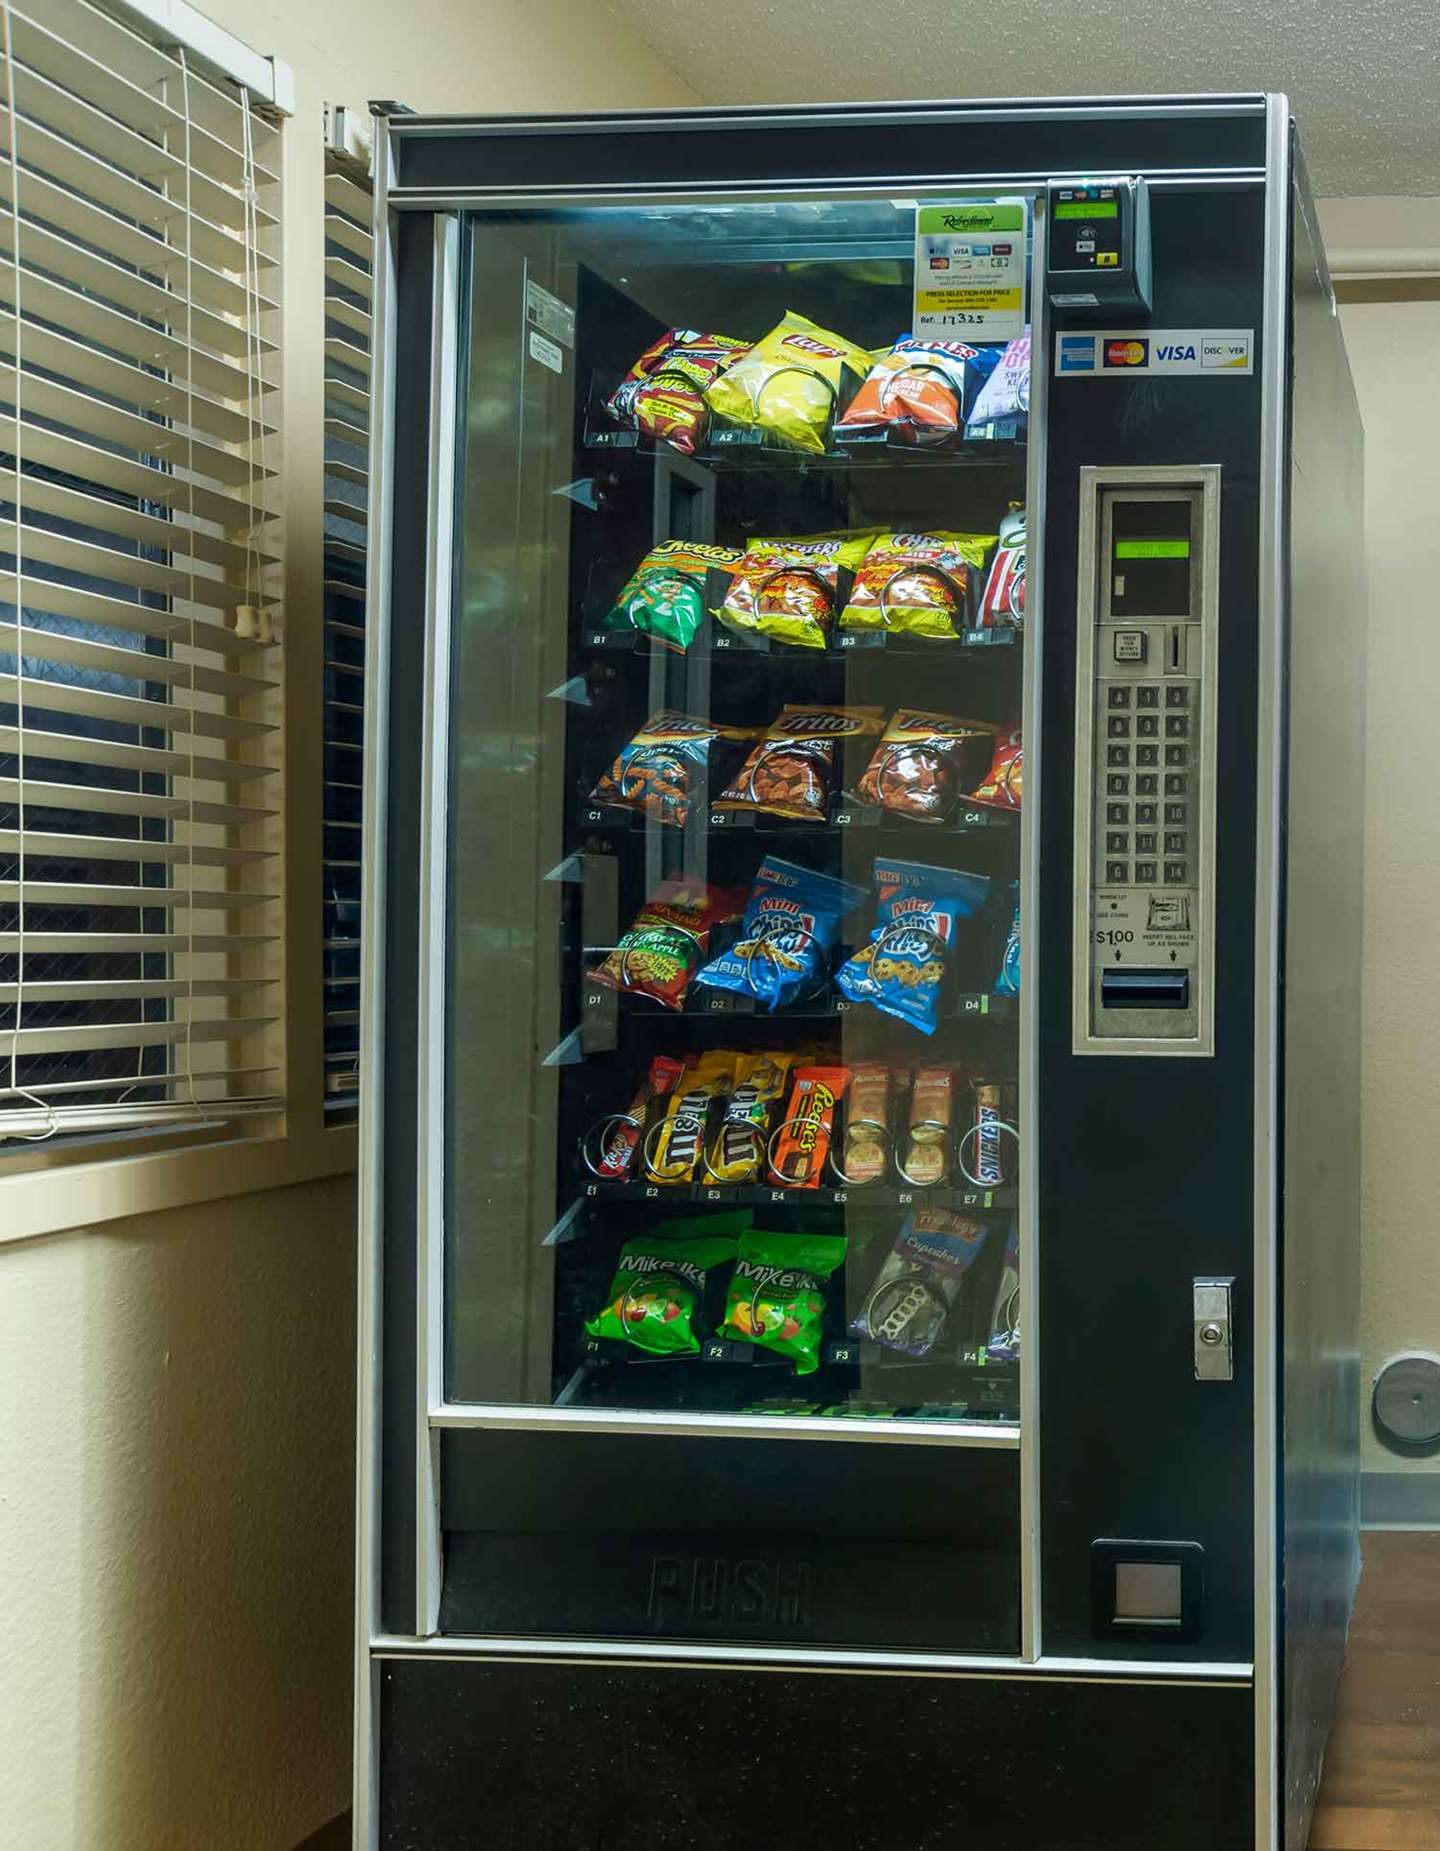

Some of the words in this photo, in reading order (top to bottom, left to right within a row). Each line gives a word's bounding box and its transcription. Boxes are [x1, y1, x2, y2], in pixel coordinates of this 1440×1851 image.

[943, 313, 984, 325] 17325
[784, 336, 840, 357] Lay's
[1156, 346, 1196, 361] VISA
[1204, 346, 1245, 355] DISCVER
[719, 434, 732, 442] A2
[652, 539, 740, 563] Cheetos
[593, 636, 605, 644] B1
[717, 639, 730, 647] B2
[842, 637, 855, 646] B3
[780, 715, 856, 732] Fritos
[589, 811, 601, 820] C1
[711, 815, 725, 824] C2
[837, 815, 851, 824] C3
[966, 813, 979, 822] C4
[589, 996, 601, 1004] D1
[711, 1001, 724, 1009] D2
[966, 1001, 979, 1010] D4
[980, 1106, 1000, 1182] SNICKERS
[587, 1185, 597, 1196] E1
[646, 1187, 658, 1197] E2
[708, 1190, 720, 1199] E3
[772, 1192, 784, 1201] E4
[899, 1193, 912, 1202] E6
[964, 1195, 977, 1204] E7
[619, 1255, 674, 1272] Mike
[588, 1342, 599, 1351] F1
[710, 1348, 722, 1357] F2
[836, 1351, 848, 1360] F3
[964, 1352, 976, 1361] F4
[647, 1556, 811, 1631] PUSH
